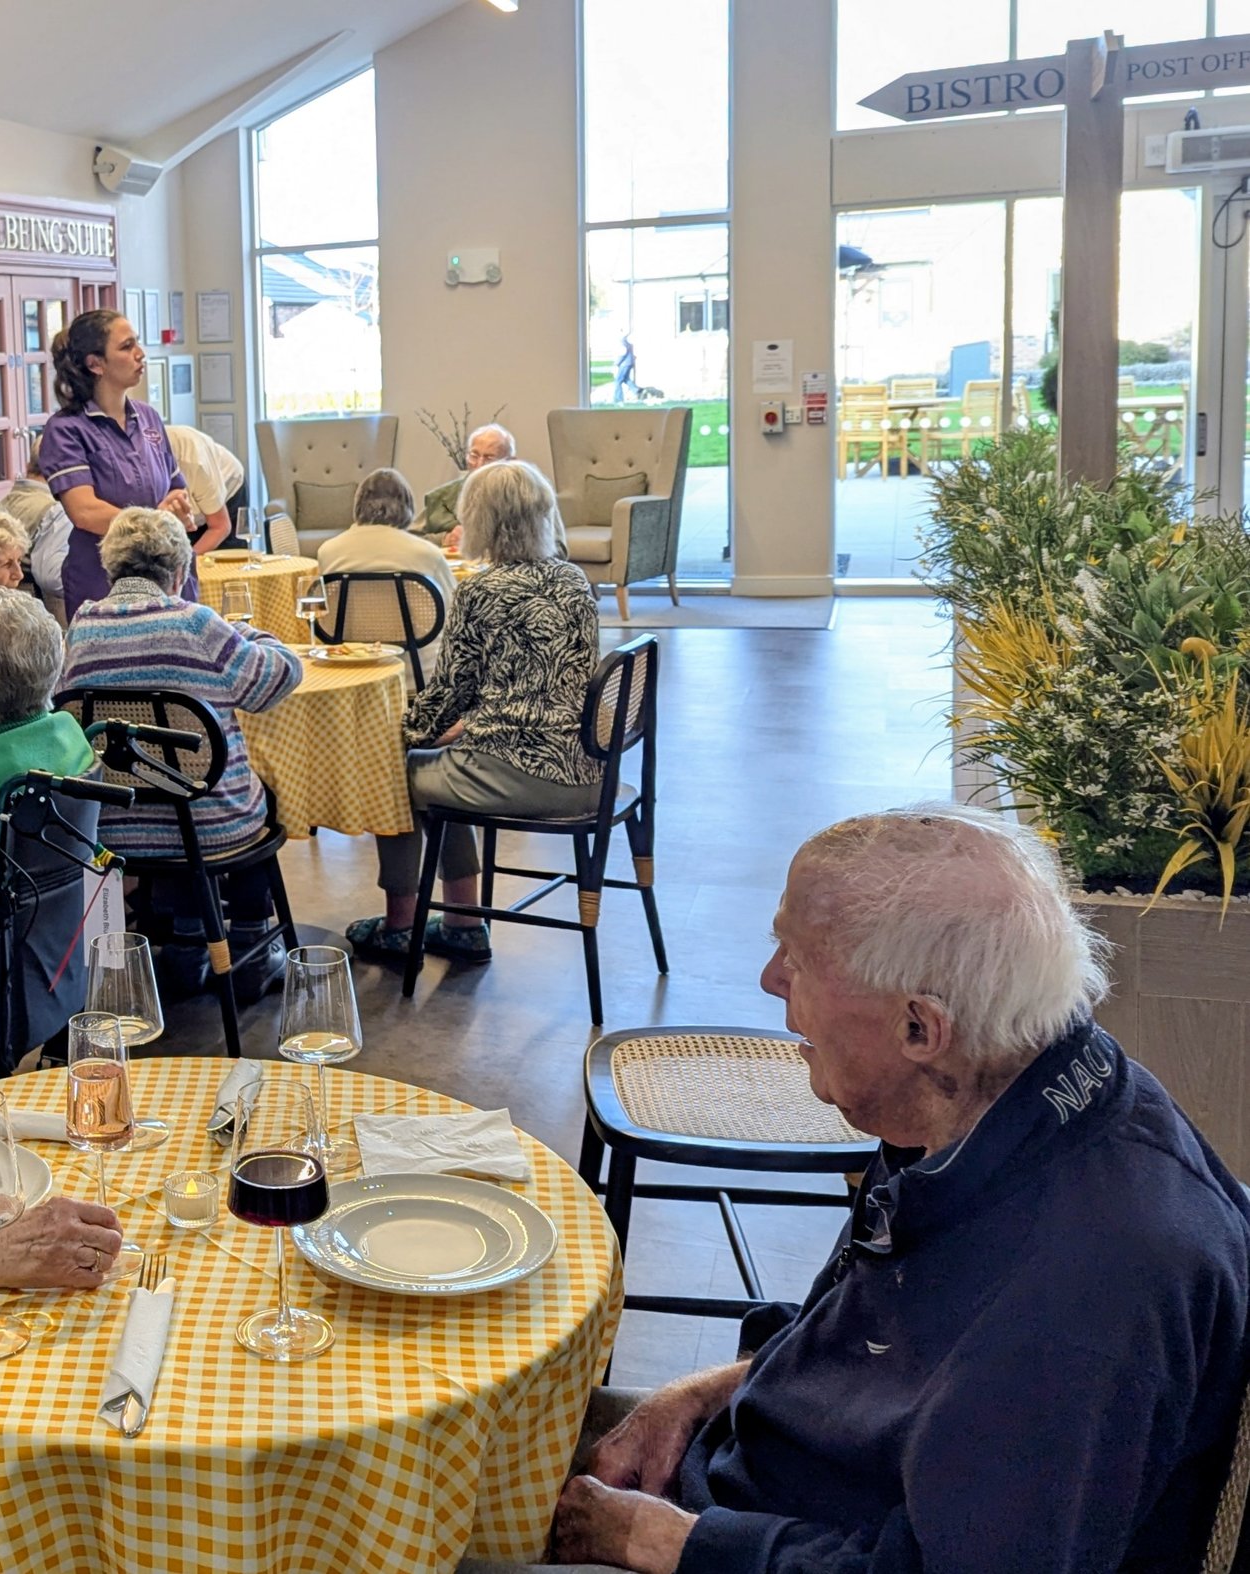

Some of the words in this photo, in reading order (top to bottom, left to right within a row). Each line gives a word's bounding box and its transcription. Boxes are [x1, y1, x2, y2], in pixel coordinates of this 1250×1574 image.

[1127, 56, 1194, 81] POST
[905, 68, 1065, 114] BISTRO
[66, 220, 115, 258] SUITE
[102, 887, 110, 920] Elizabeth
